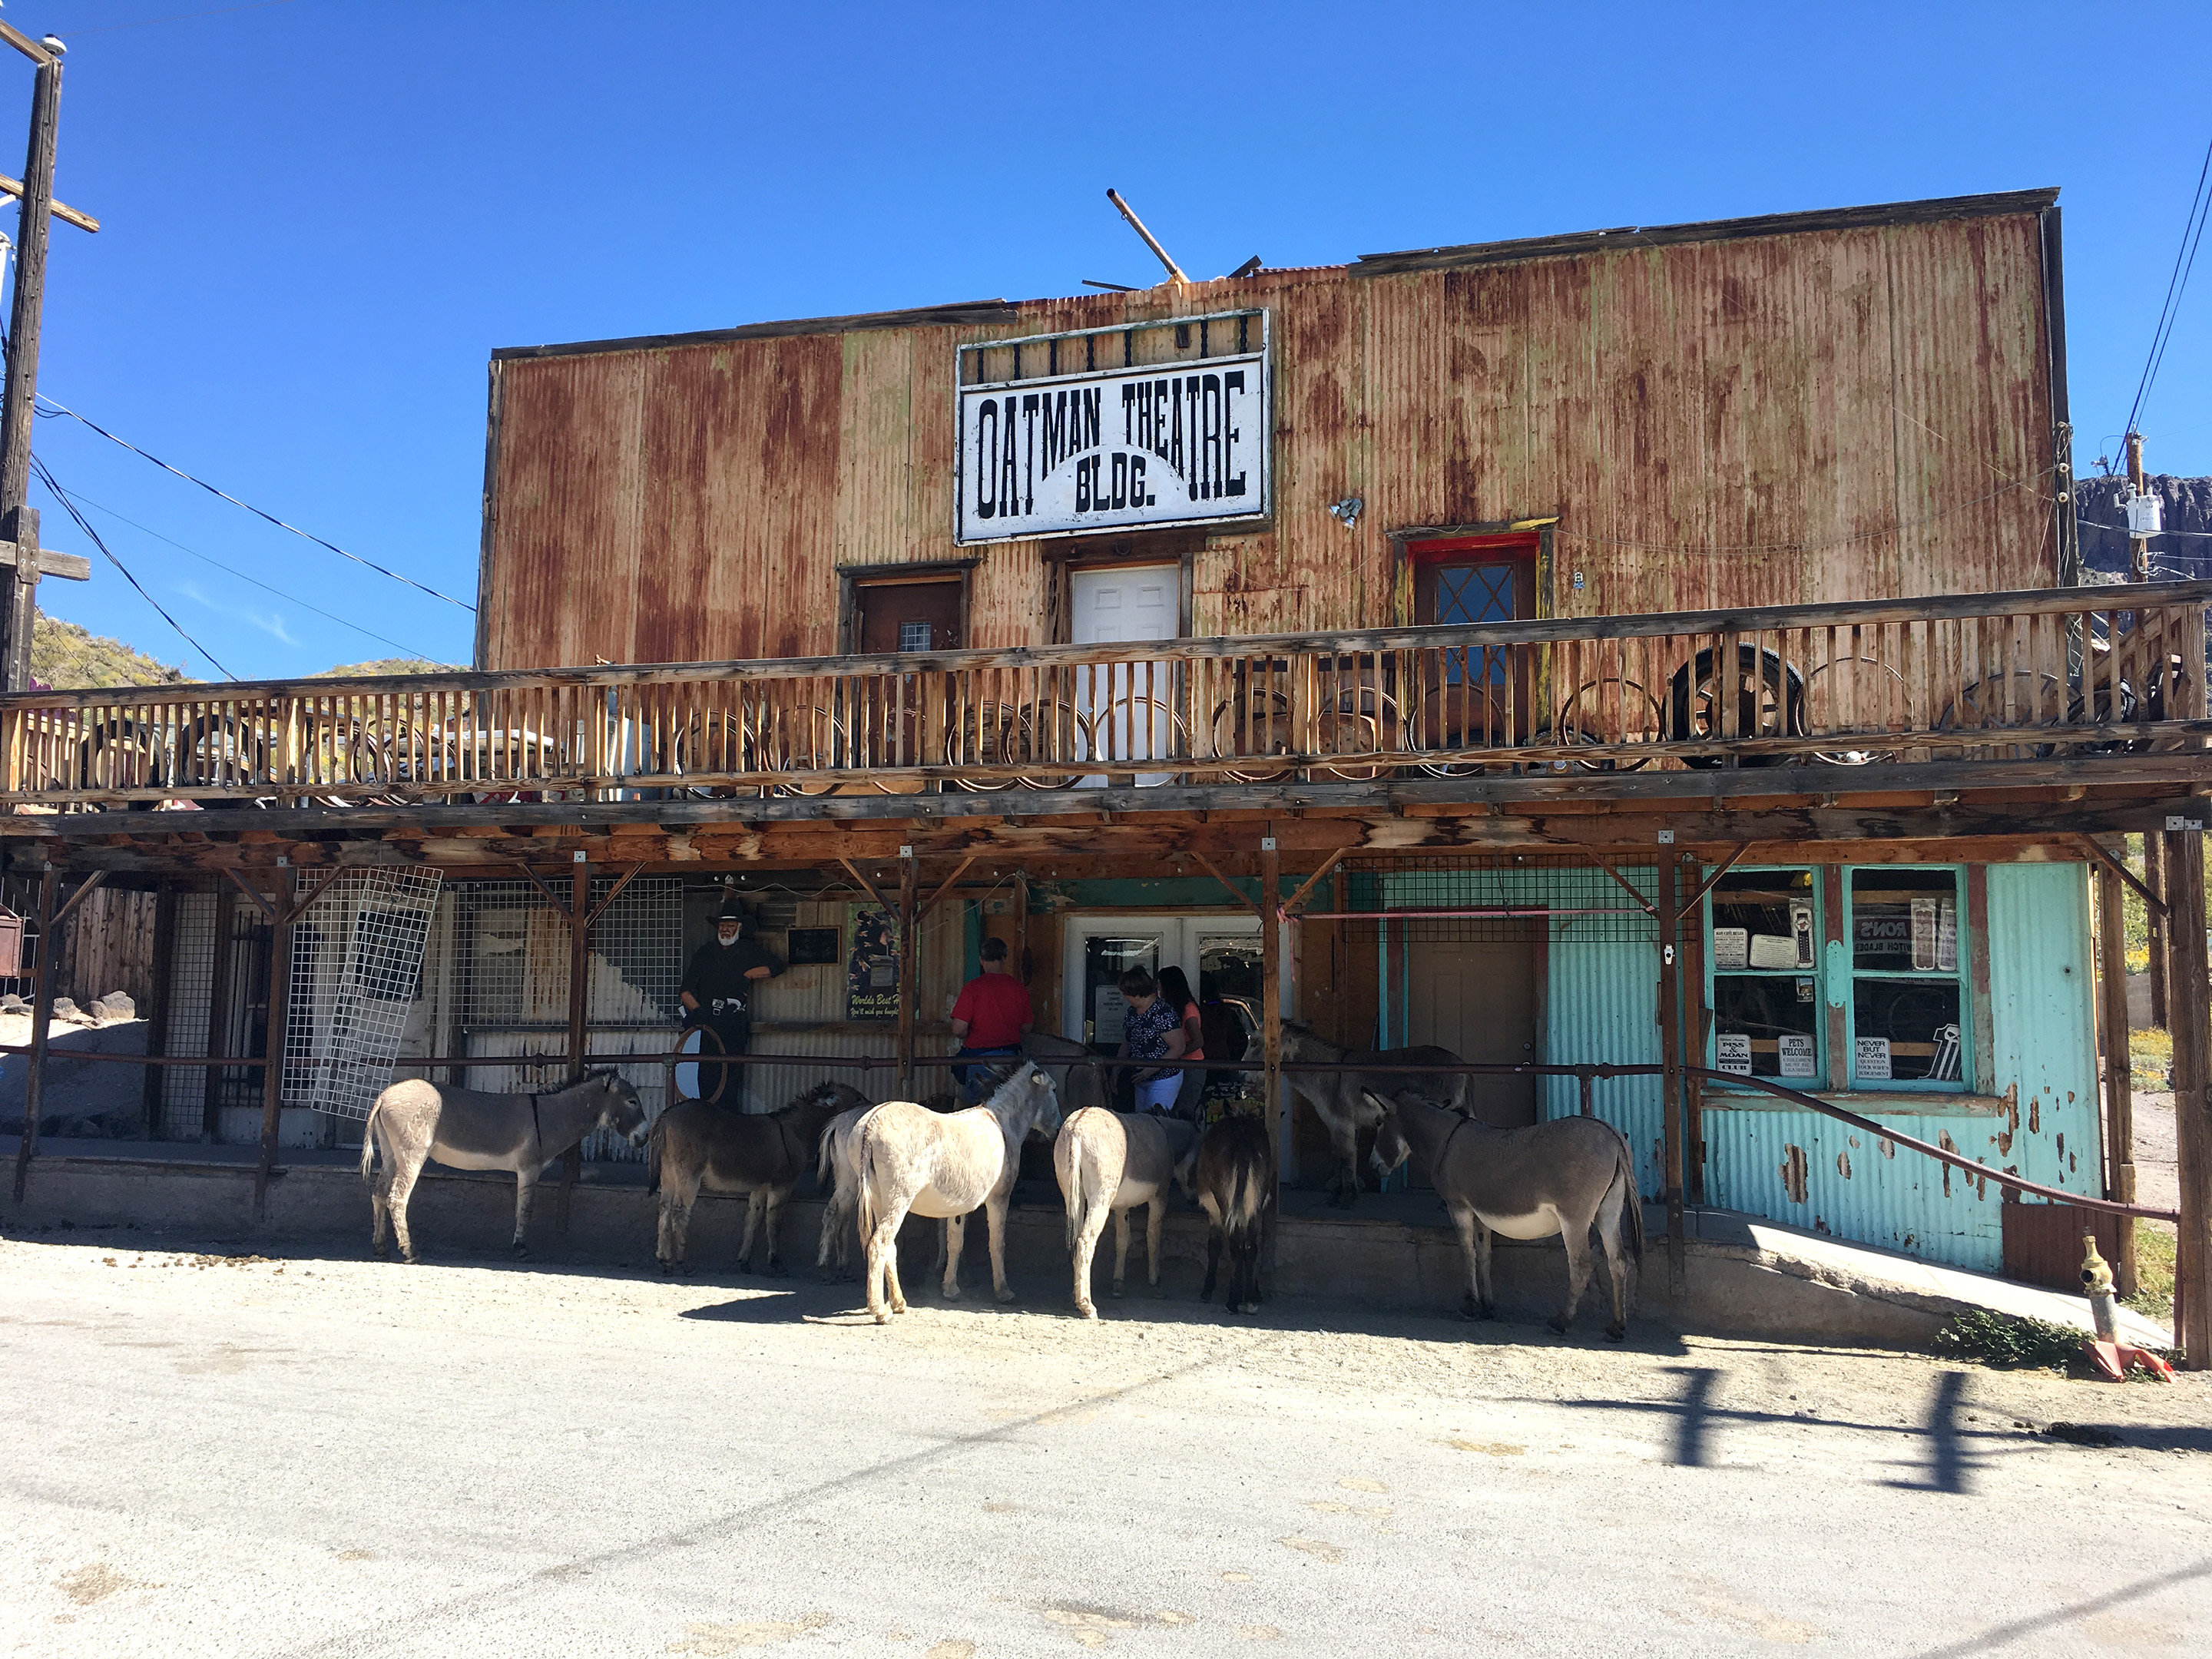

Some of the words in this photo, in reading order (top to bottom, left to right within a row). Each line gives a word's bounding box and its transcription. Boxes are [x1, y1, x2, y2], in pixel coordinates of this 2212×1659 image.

[978, 387, 1101, 519] OATMAN
[1122, 370, 1246, 502] THEATRE
[1076, 452, 1156, 513] BLDG.
[876, 993, 892, 1005] Best
[1789, 1038, 1804, 1047] PETS
[1781, 1048, 1813, 1056] WELCOME
